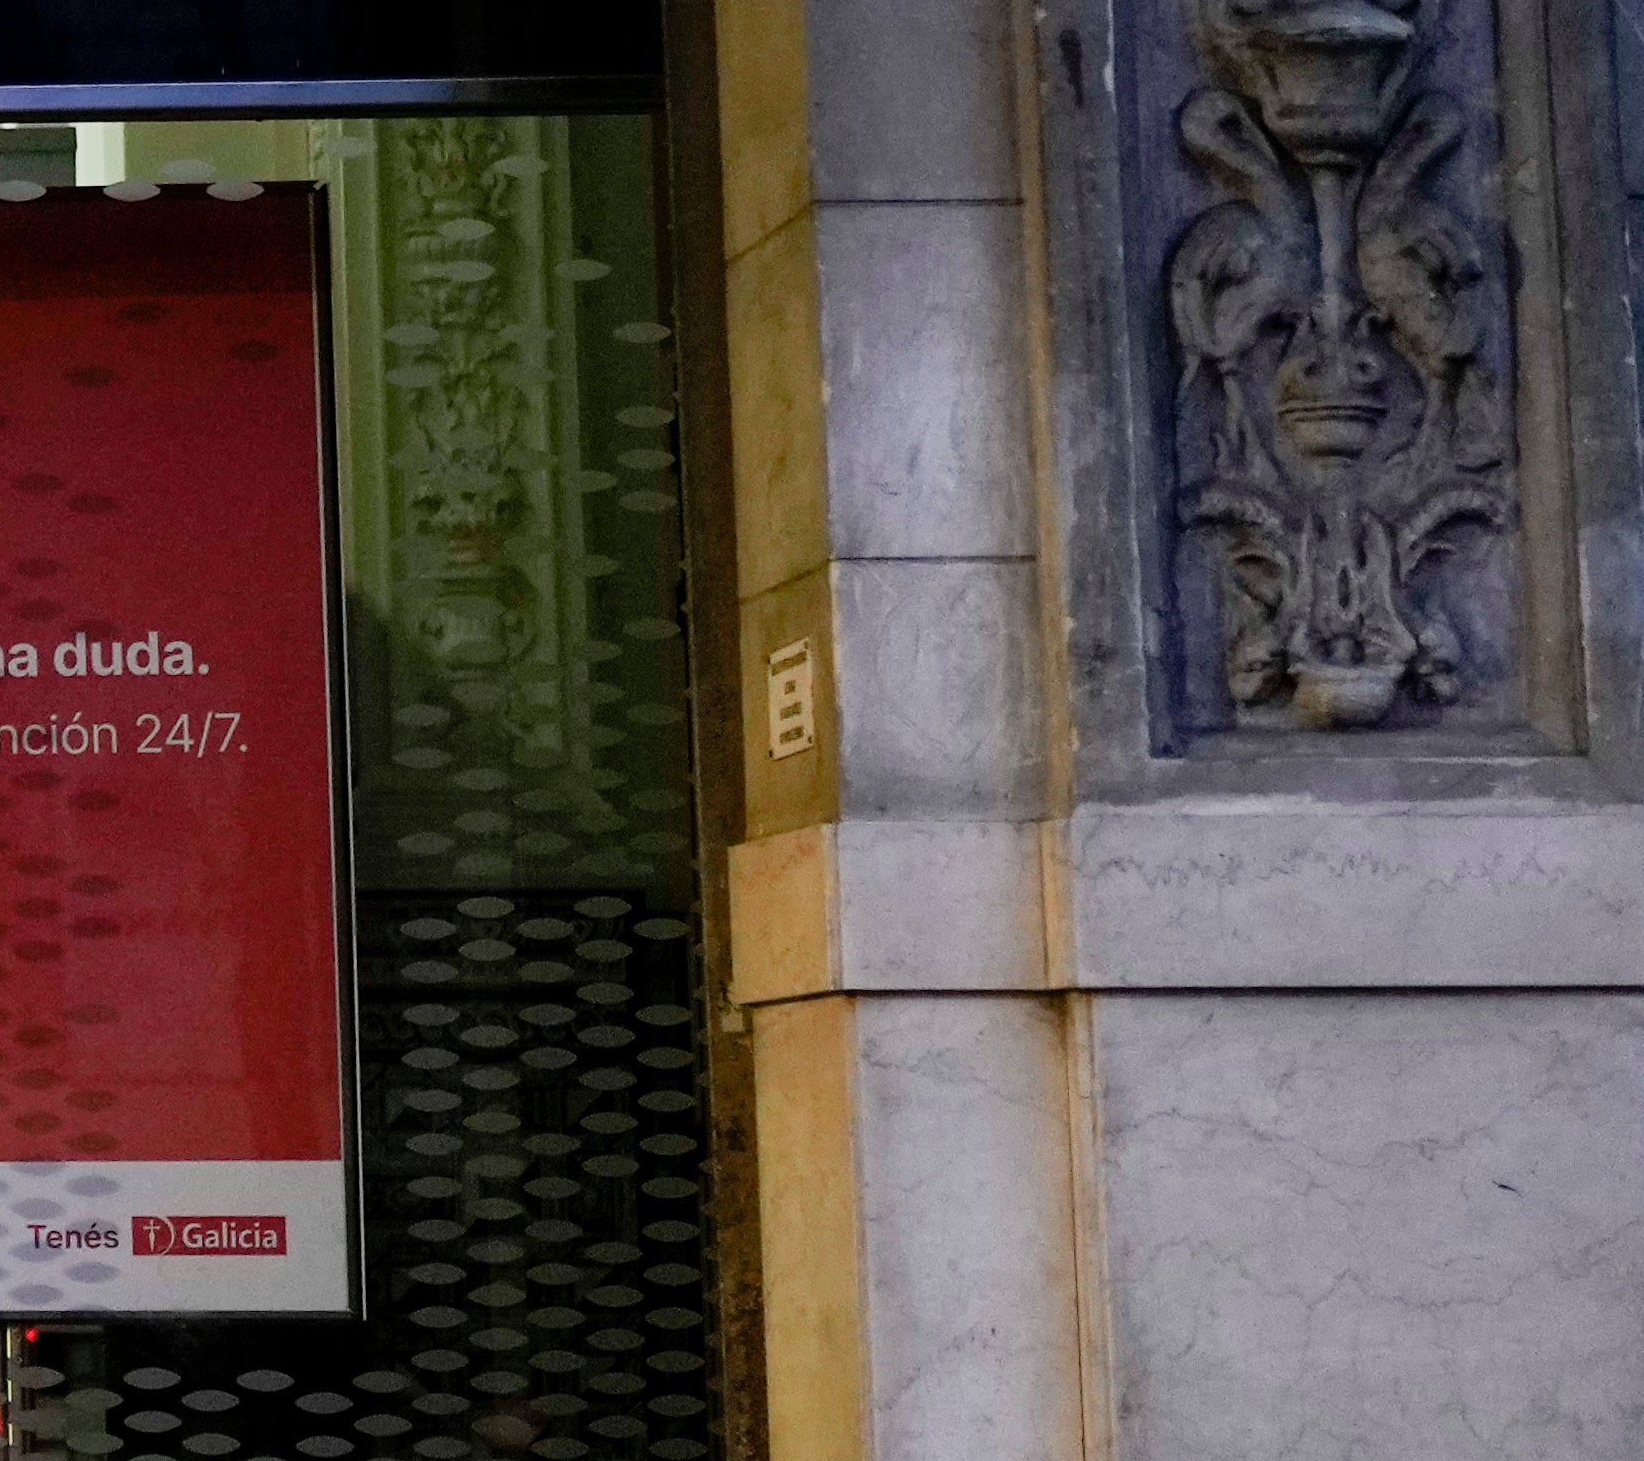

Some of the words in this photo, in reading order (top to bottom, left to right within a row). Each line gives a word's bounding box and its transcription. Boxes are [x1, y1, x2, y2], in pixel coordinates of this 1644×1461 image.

[53, 632, 211, 677] duda.
[136, 712, 249, 758] 24/7.
[28, 1224, 120, 1250] Tenés
[182, 1222, 279, 1250] Galicia
